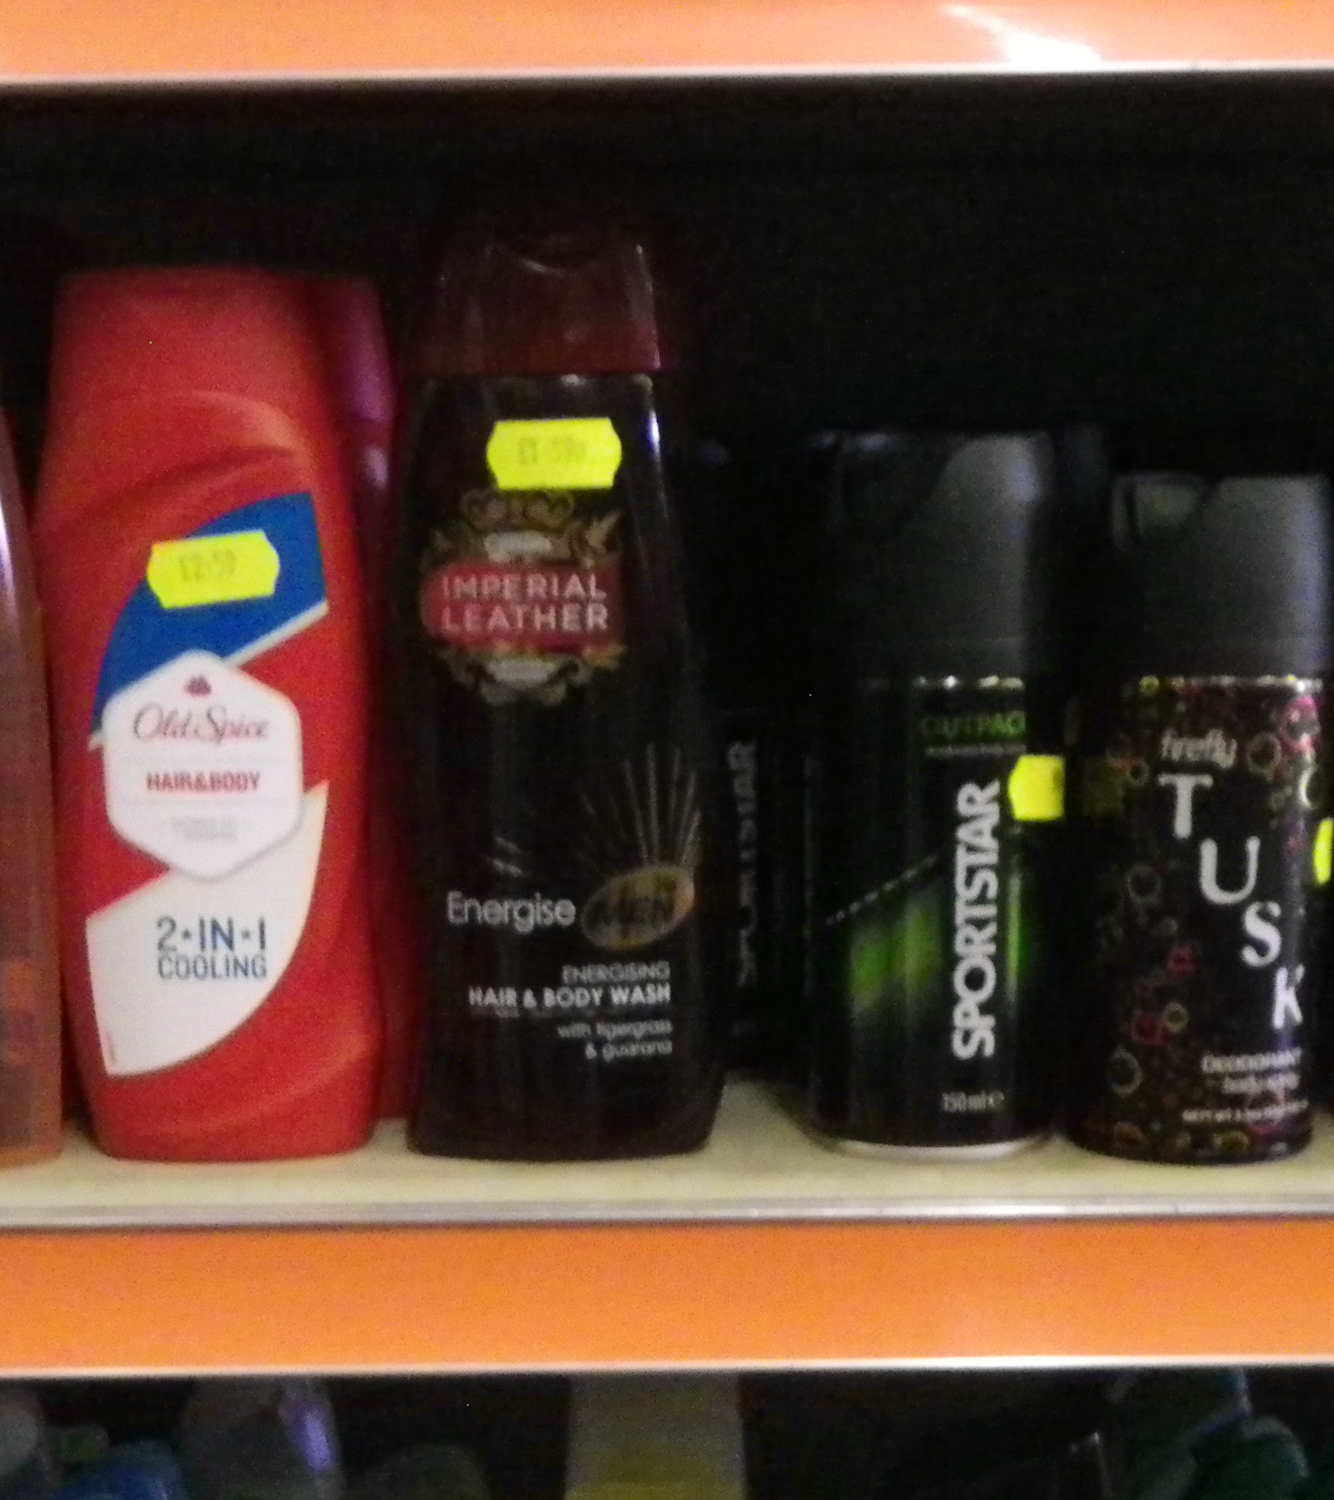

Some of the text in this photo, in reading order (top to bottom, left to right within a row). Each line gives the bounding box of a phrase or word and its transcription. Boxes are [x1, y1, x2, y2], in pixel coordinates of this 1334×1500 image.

[442, 573, 608, 601] IMPERIAL
[440, 603, 609, 634] LEATHER
[952, 778, 1001, 1060] SPORTSTAR
[157, 955, 268, 981] COOLING
[468, 985, 518, 1009] HAIR
[543, 985, 604, 1009] BODY
[609, 981, 672, 1006] WASH
